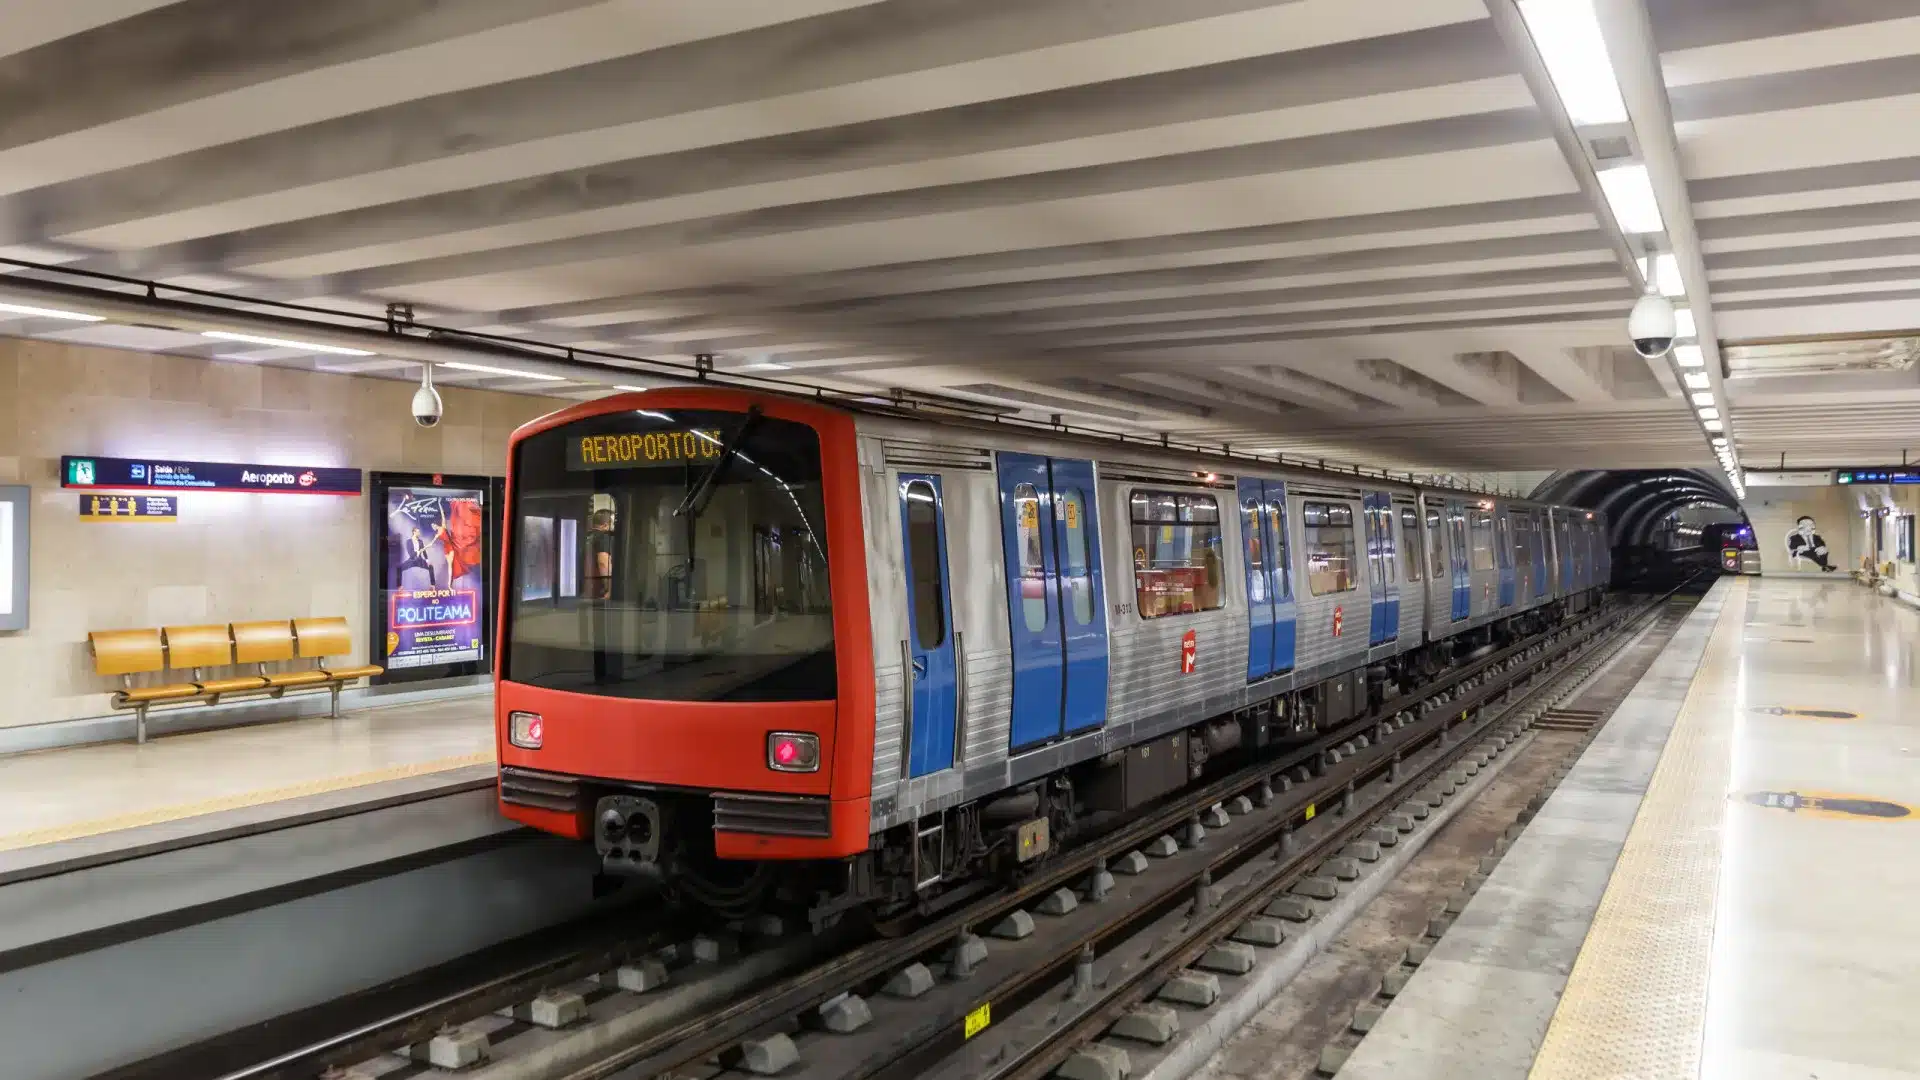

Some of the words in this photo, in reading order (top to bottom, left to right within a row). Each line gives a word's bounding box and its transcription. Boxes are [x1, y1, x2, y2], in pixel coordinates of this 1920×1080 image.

[581, 432, 697, 463] AEROPORTO
[241, 470, 295, 486] Aeroporto
[412, 590, 437, 599] ESPERO
[438, 590, 450, 598] POR
[450, 589, 456, 597] TI
[397, 604, 472, 623] POLITEAMA
